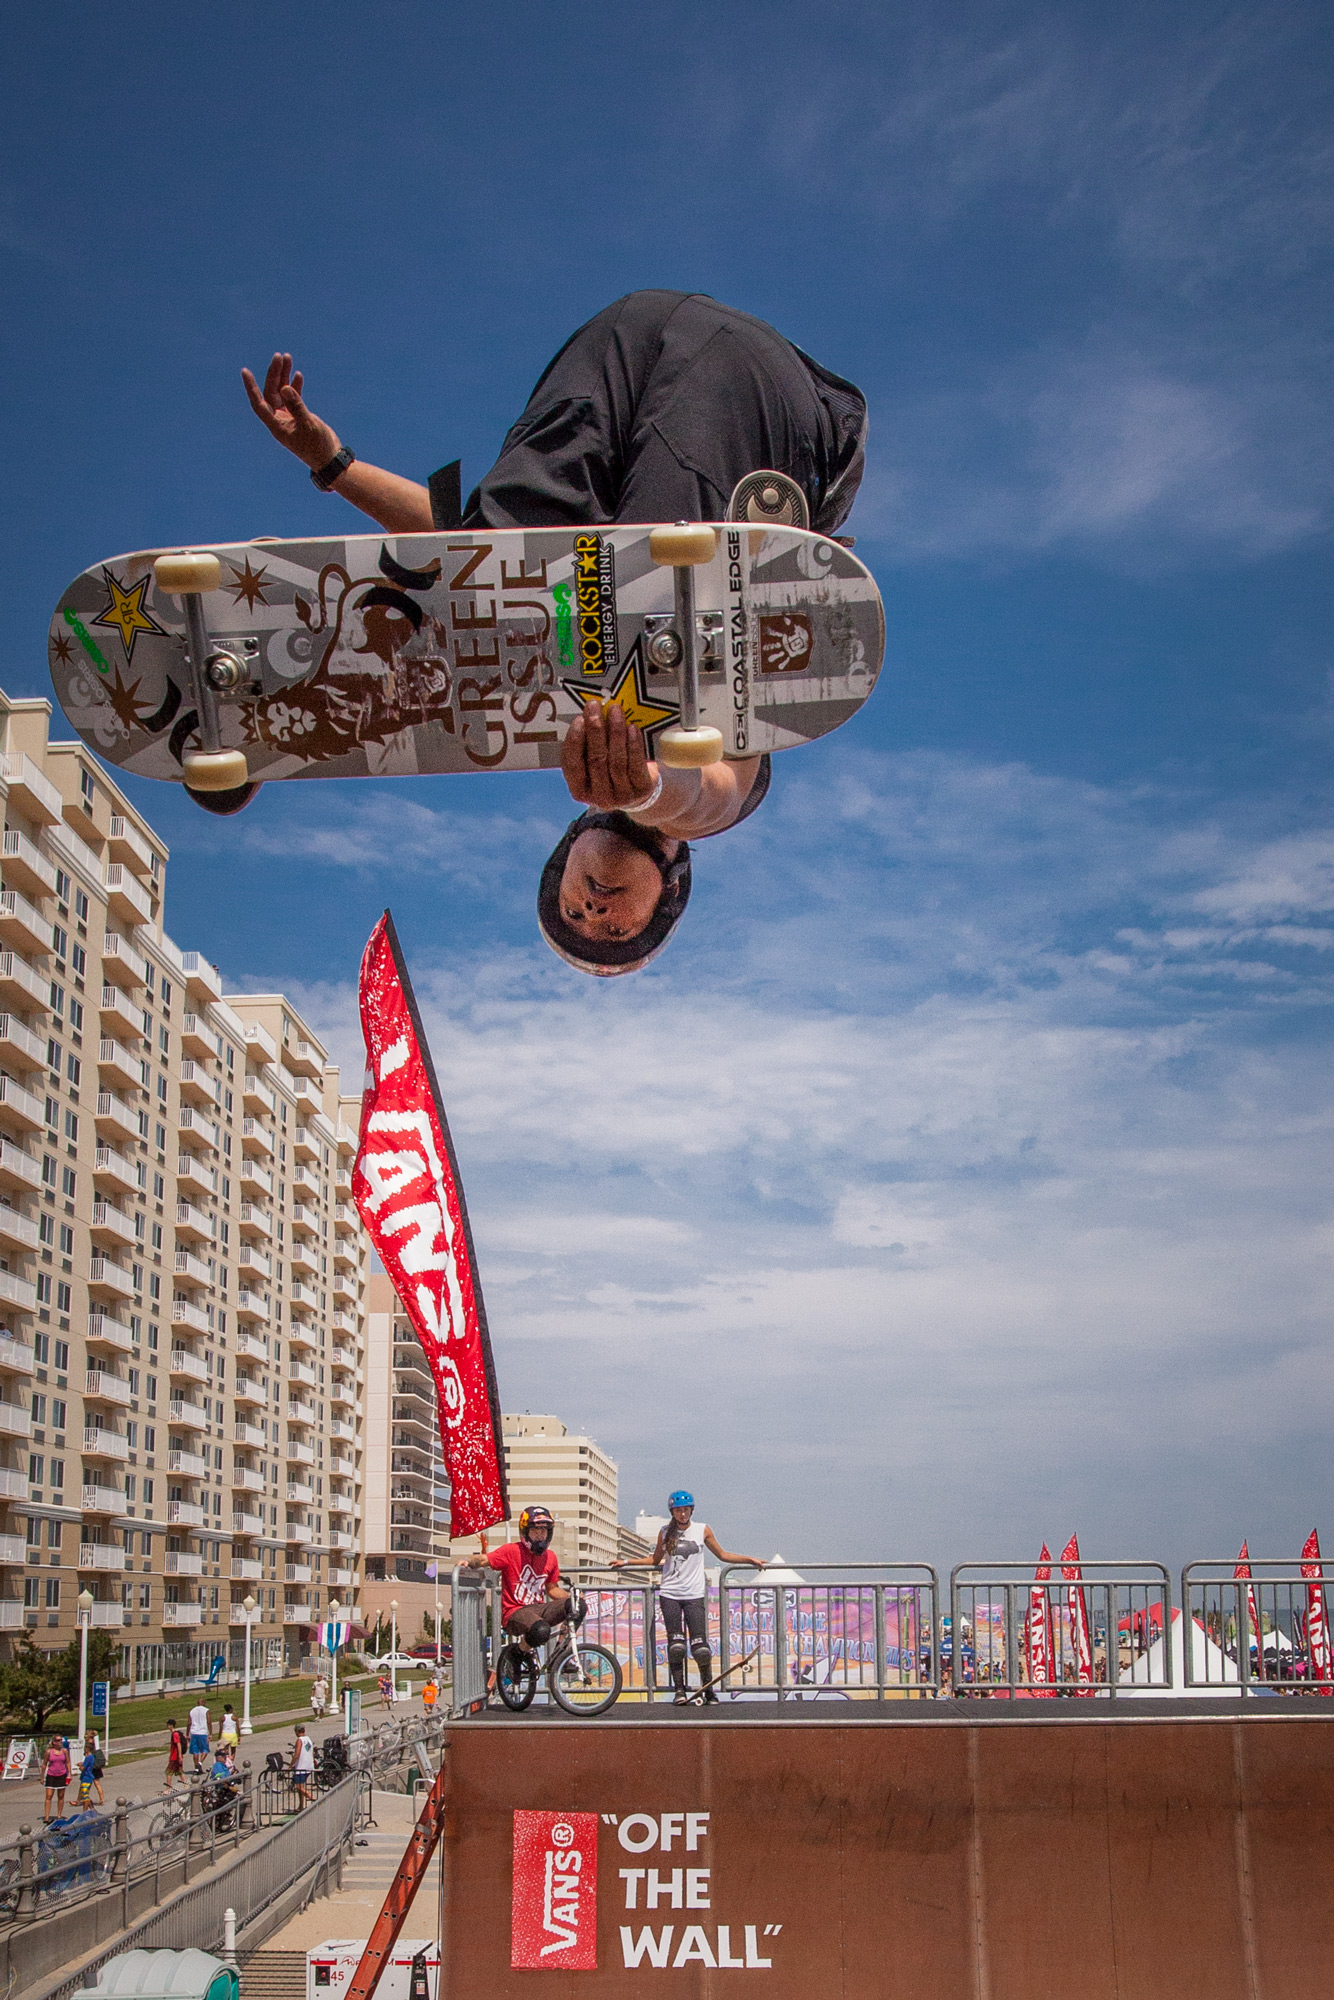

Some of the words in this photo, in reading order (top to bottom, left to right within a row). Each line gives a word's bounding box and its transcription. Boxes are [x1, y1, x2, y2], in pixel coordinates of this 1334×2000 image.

[598, 546, 612, 595] DRINK
[727, 530, 742, 593] EDGE
[446, 543, 508, 767] GREEN
[500, 557, 560, 745] ISSUE
[601, 602, 616, 664] ENERGY
[730, 598, 744, 711] COASTAL
[618, 1868, 711, 1909] THE
[330, 1970, 345, 1982] 45
